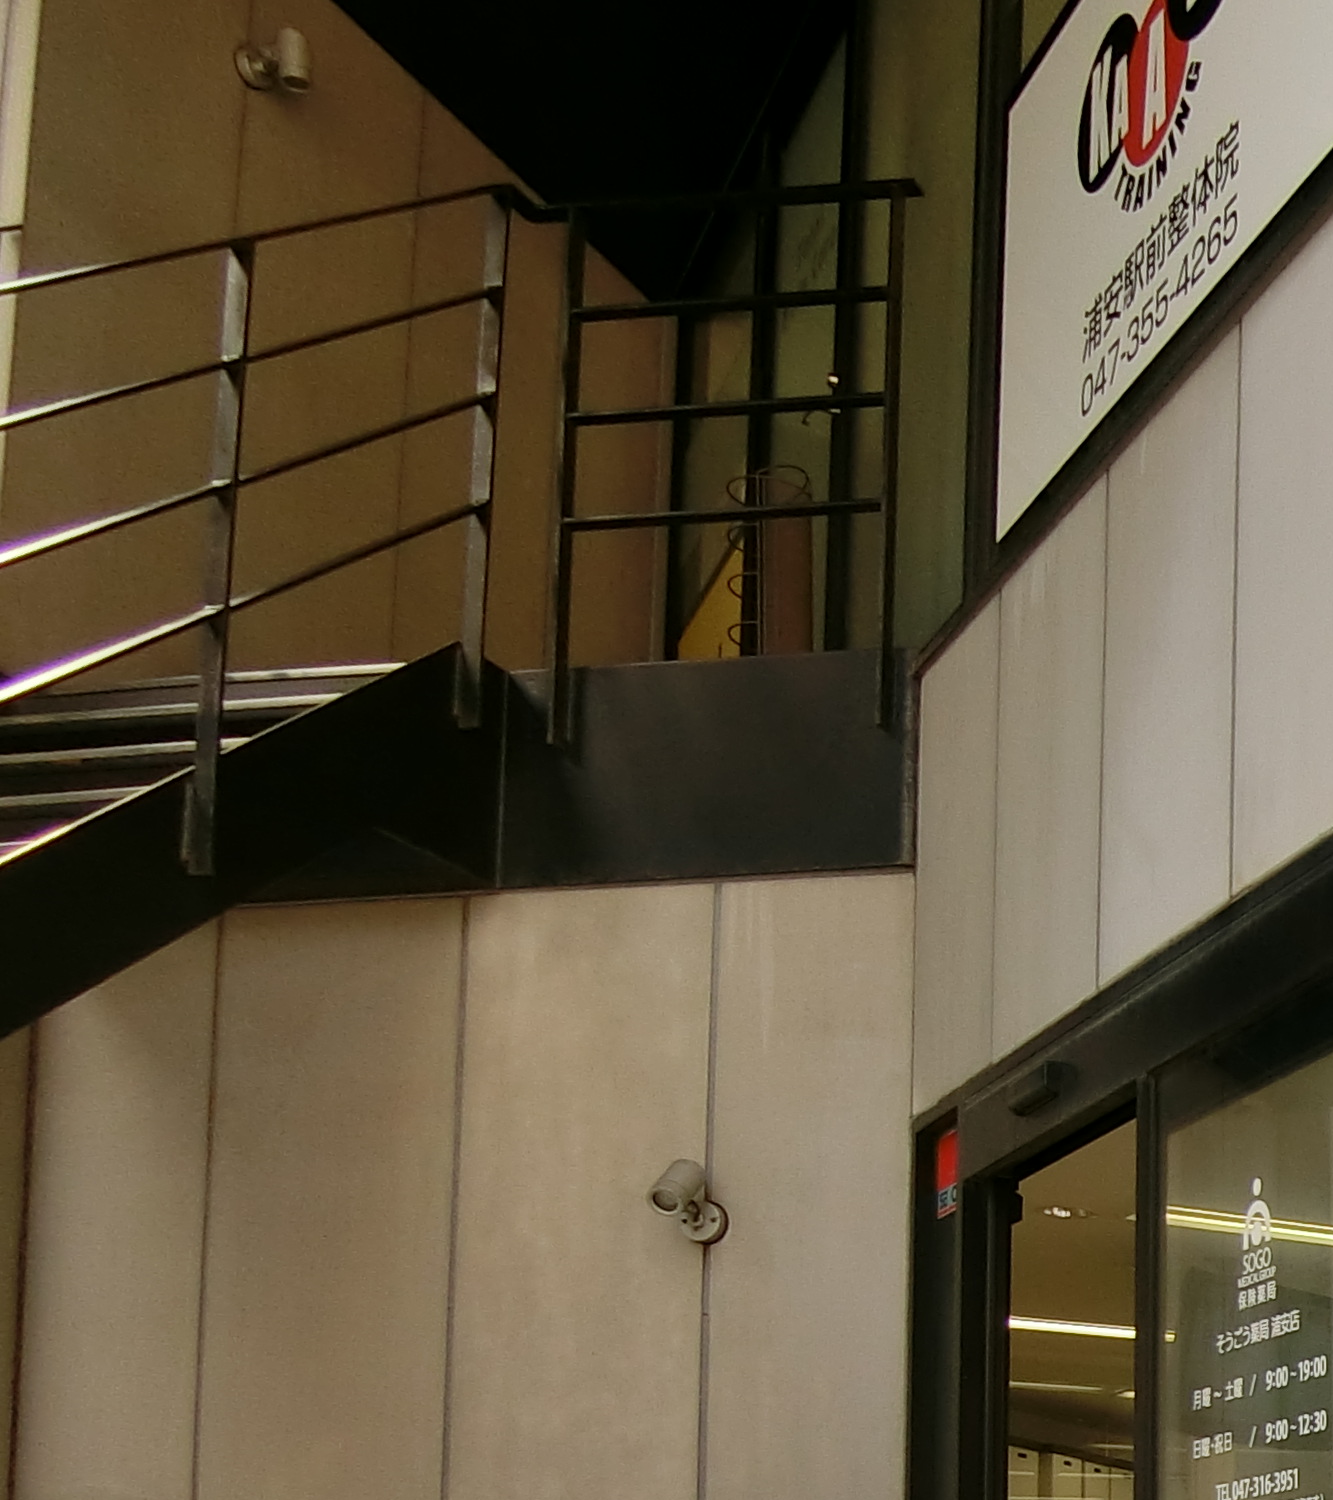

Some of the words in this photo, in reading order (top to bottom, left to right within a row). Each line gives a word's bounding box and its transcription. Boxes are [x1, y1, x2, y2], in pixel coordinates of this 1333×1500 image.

[1114, 60, 1203, 213] TRAINING
[1082, 120, 1240, 364] 浦安駅前整体院
[1081, 193, 1239, 417] 047-355-4265
[1238, 1280, 1277, 1311] 保険薬局
[1242, 1247, 1272, 1275] SOGO
[1216, 1318, 1269, 1354] そうごう薬局
